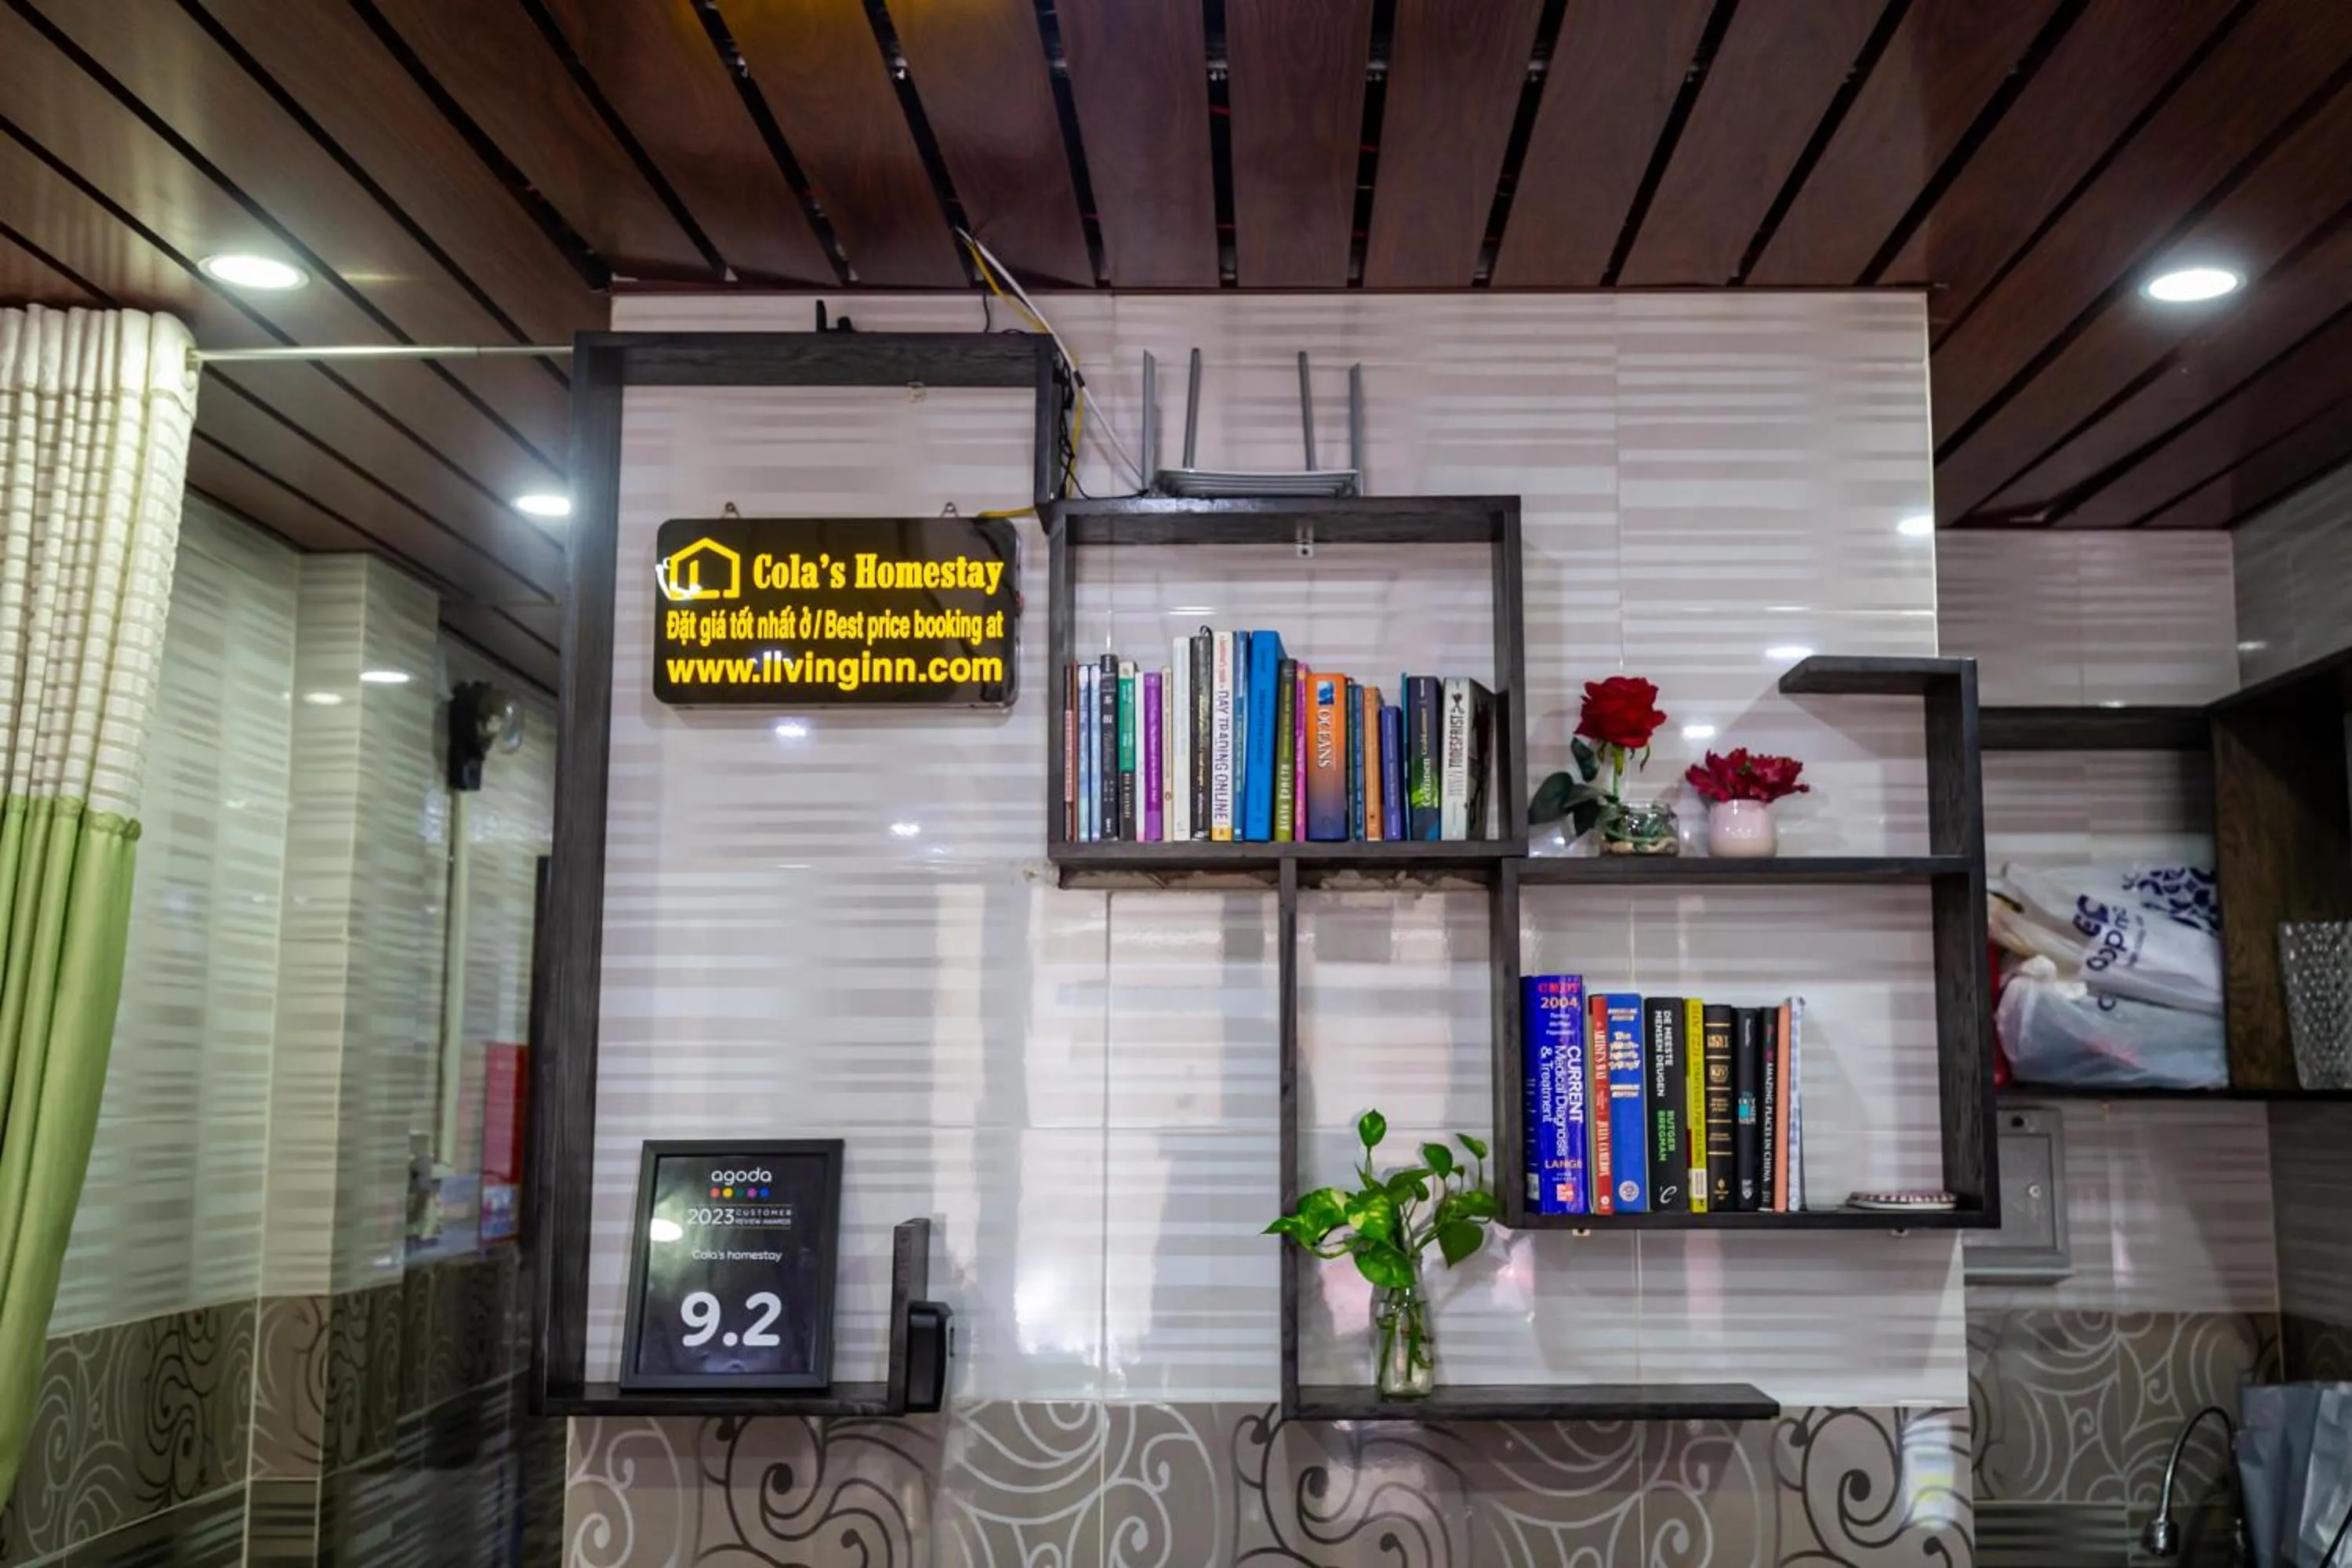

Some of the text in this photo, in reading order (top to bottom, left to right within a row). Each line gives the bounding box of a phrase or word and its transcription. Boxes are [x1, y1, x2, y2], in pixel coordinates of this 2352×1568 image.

[753, 553, 1004, 596] Cola's Homestay
[666, 609, 696, 646] Đặt
[699, 608, 727, 647] giá
[729, 605, 754, 640] tốt
[757, 604, 796, 640] nhất
[825, 609, 865, 640] Best
[866, 608, 910, 647] price
[913, 608, 983, 647] booking
[985, 610, 1004, 640] at
[666, 651, 1003, 691] www.livinginn.com
[1215, 717, 1229, 771] TRADING
[1316, 707, 1332, 769] OCEANS
[1214, 773, 1229, 819] ONLINE
[1540, 996, 1577, 1010] 2004
[1654, 1010, 1666, 1097] MENSEN DEUGEN
[1662, 1010, 1674, 1067] DE MEESTE
[1540, 1045, 1554, 1123] & Treatment
[1554, 1044, 1567, 1094] Medical
[1567, 1044, 1583, 1123] CURRENT
[1553, 1094, 1568, 1157] Diagnosis
[1657, 1109, 1668, 1162] BREGMAN
[1666, 1109, 1675, 1152] RUTGER
[1763, 1062, 1774, 1182] AMAZING PLACES IN CHINA
[711, 1167, 772, 1186] agoda
[687, 1208, 735, 1225] 2023
[727, 1249, 782, 1262] homestay
[680, 1291, 782, 1347] 9.2
